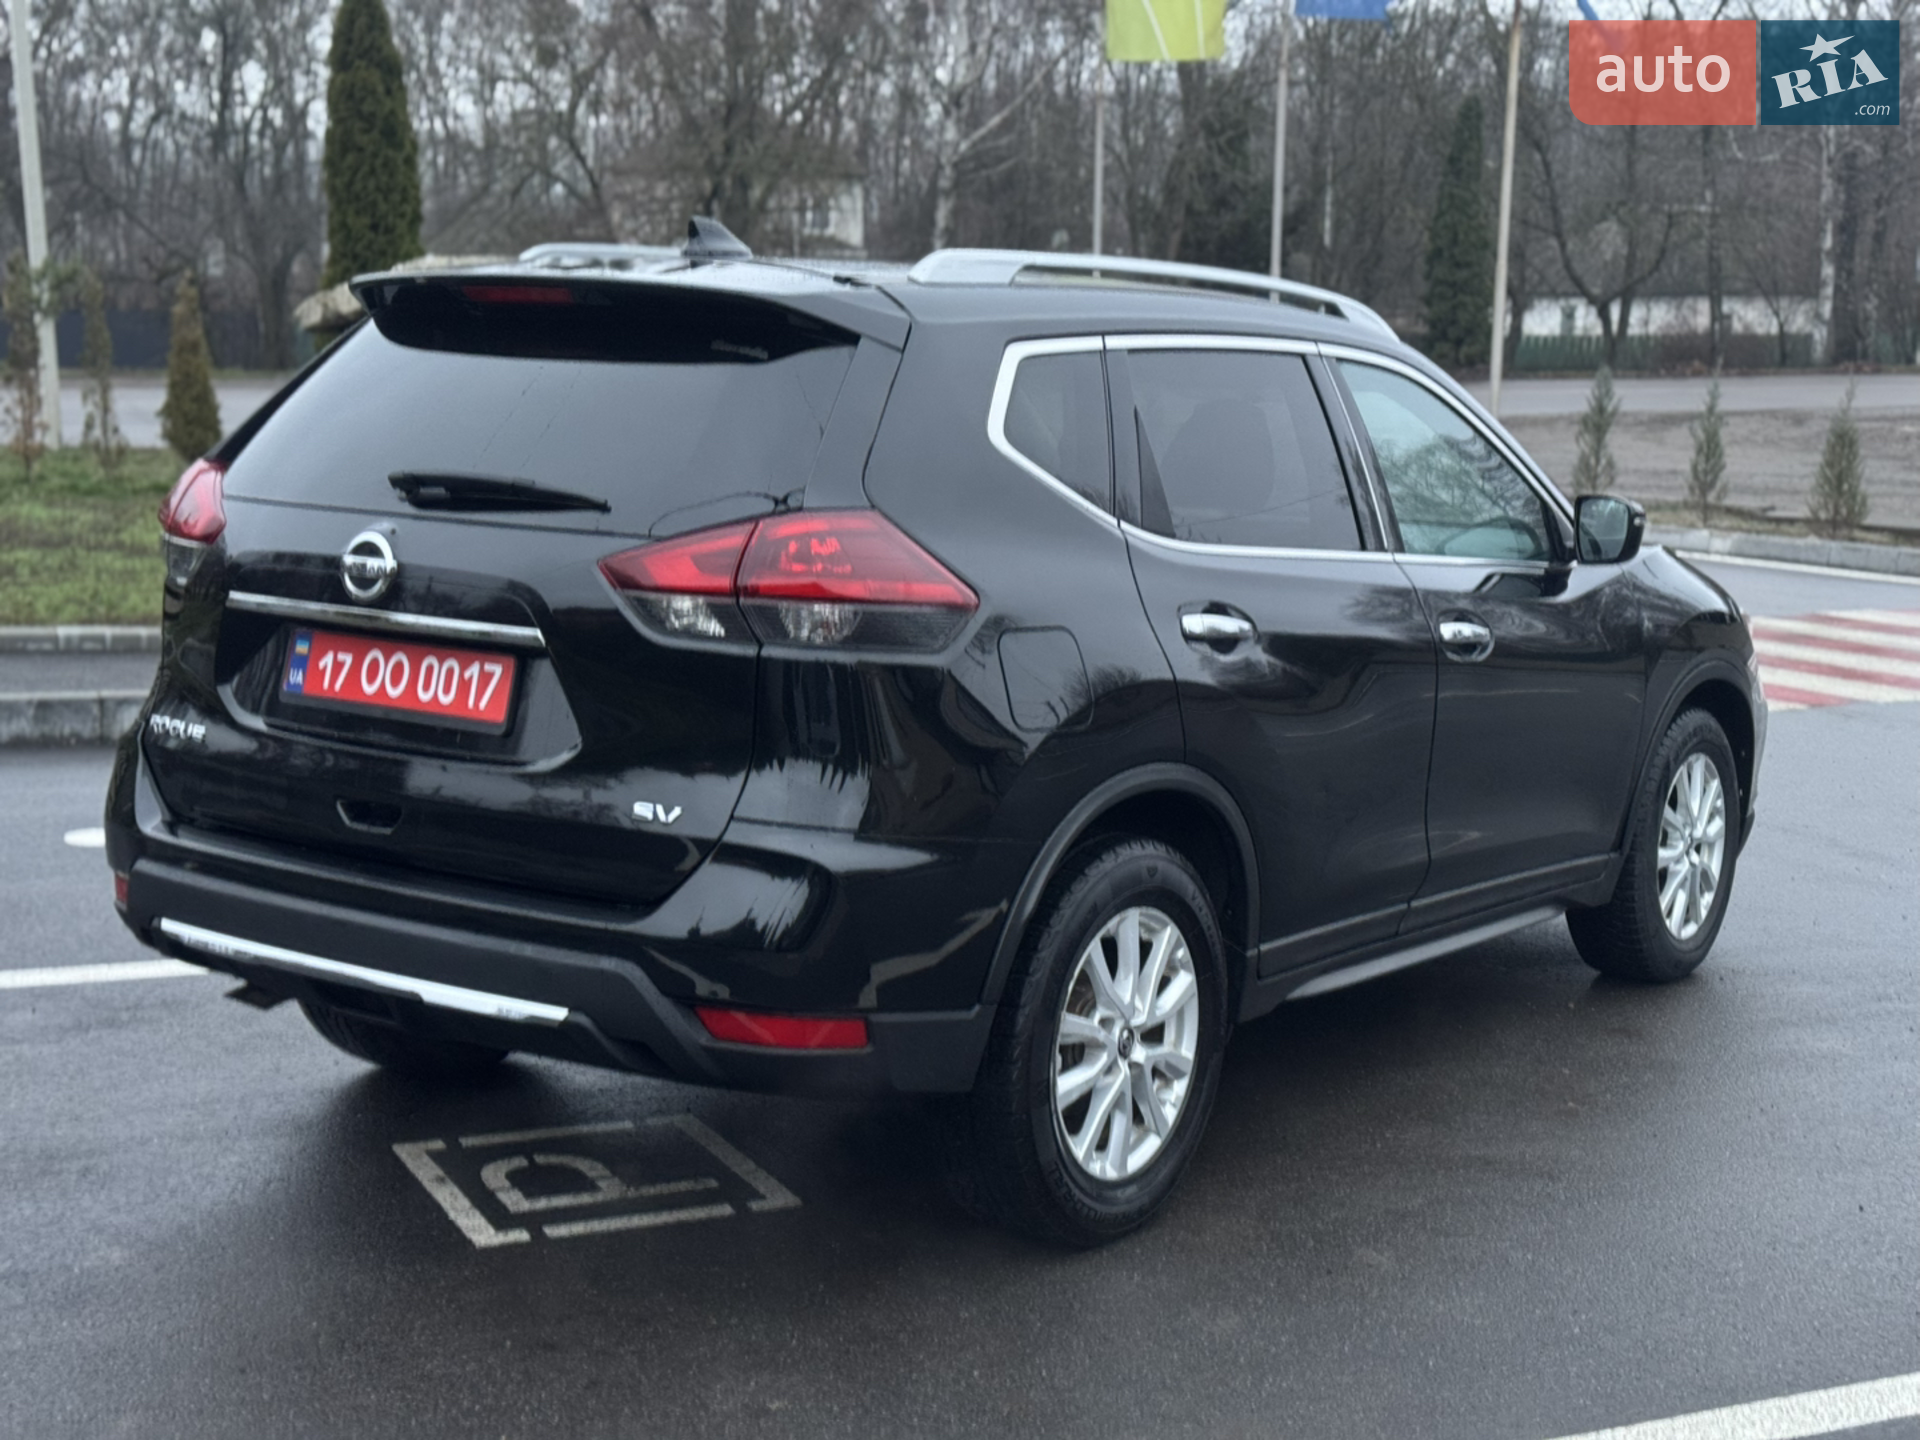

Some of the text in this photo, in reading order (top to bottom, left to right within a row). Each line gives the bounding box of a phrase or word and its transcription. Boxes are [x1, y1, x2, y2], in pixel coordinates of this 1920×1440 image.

[289, 668, 304, 685] UA
[318, 650, 353, 692] 17
[416, 654, 503, 711] 0017
[632, 801, 682, 824] SV
